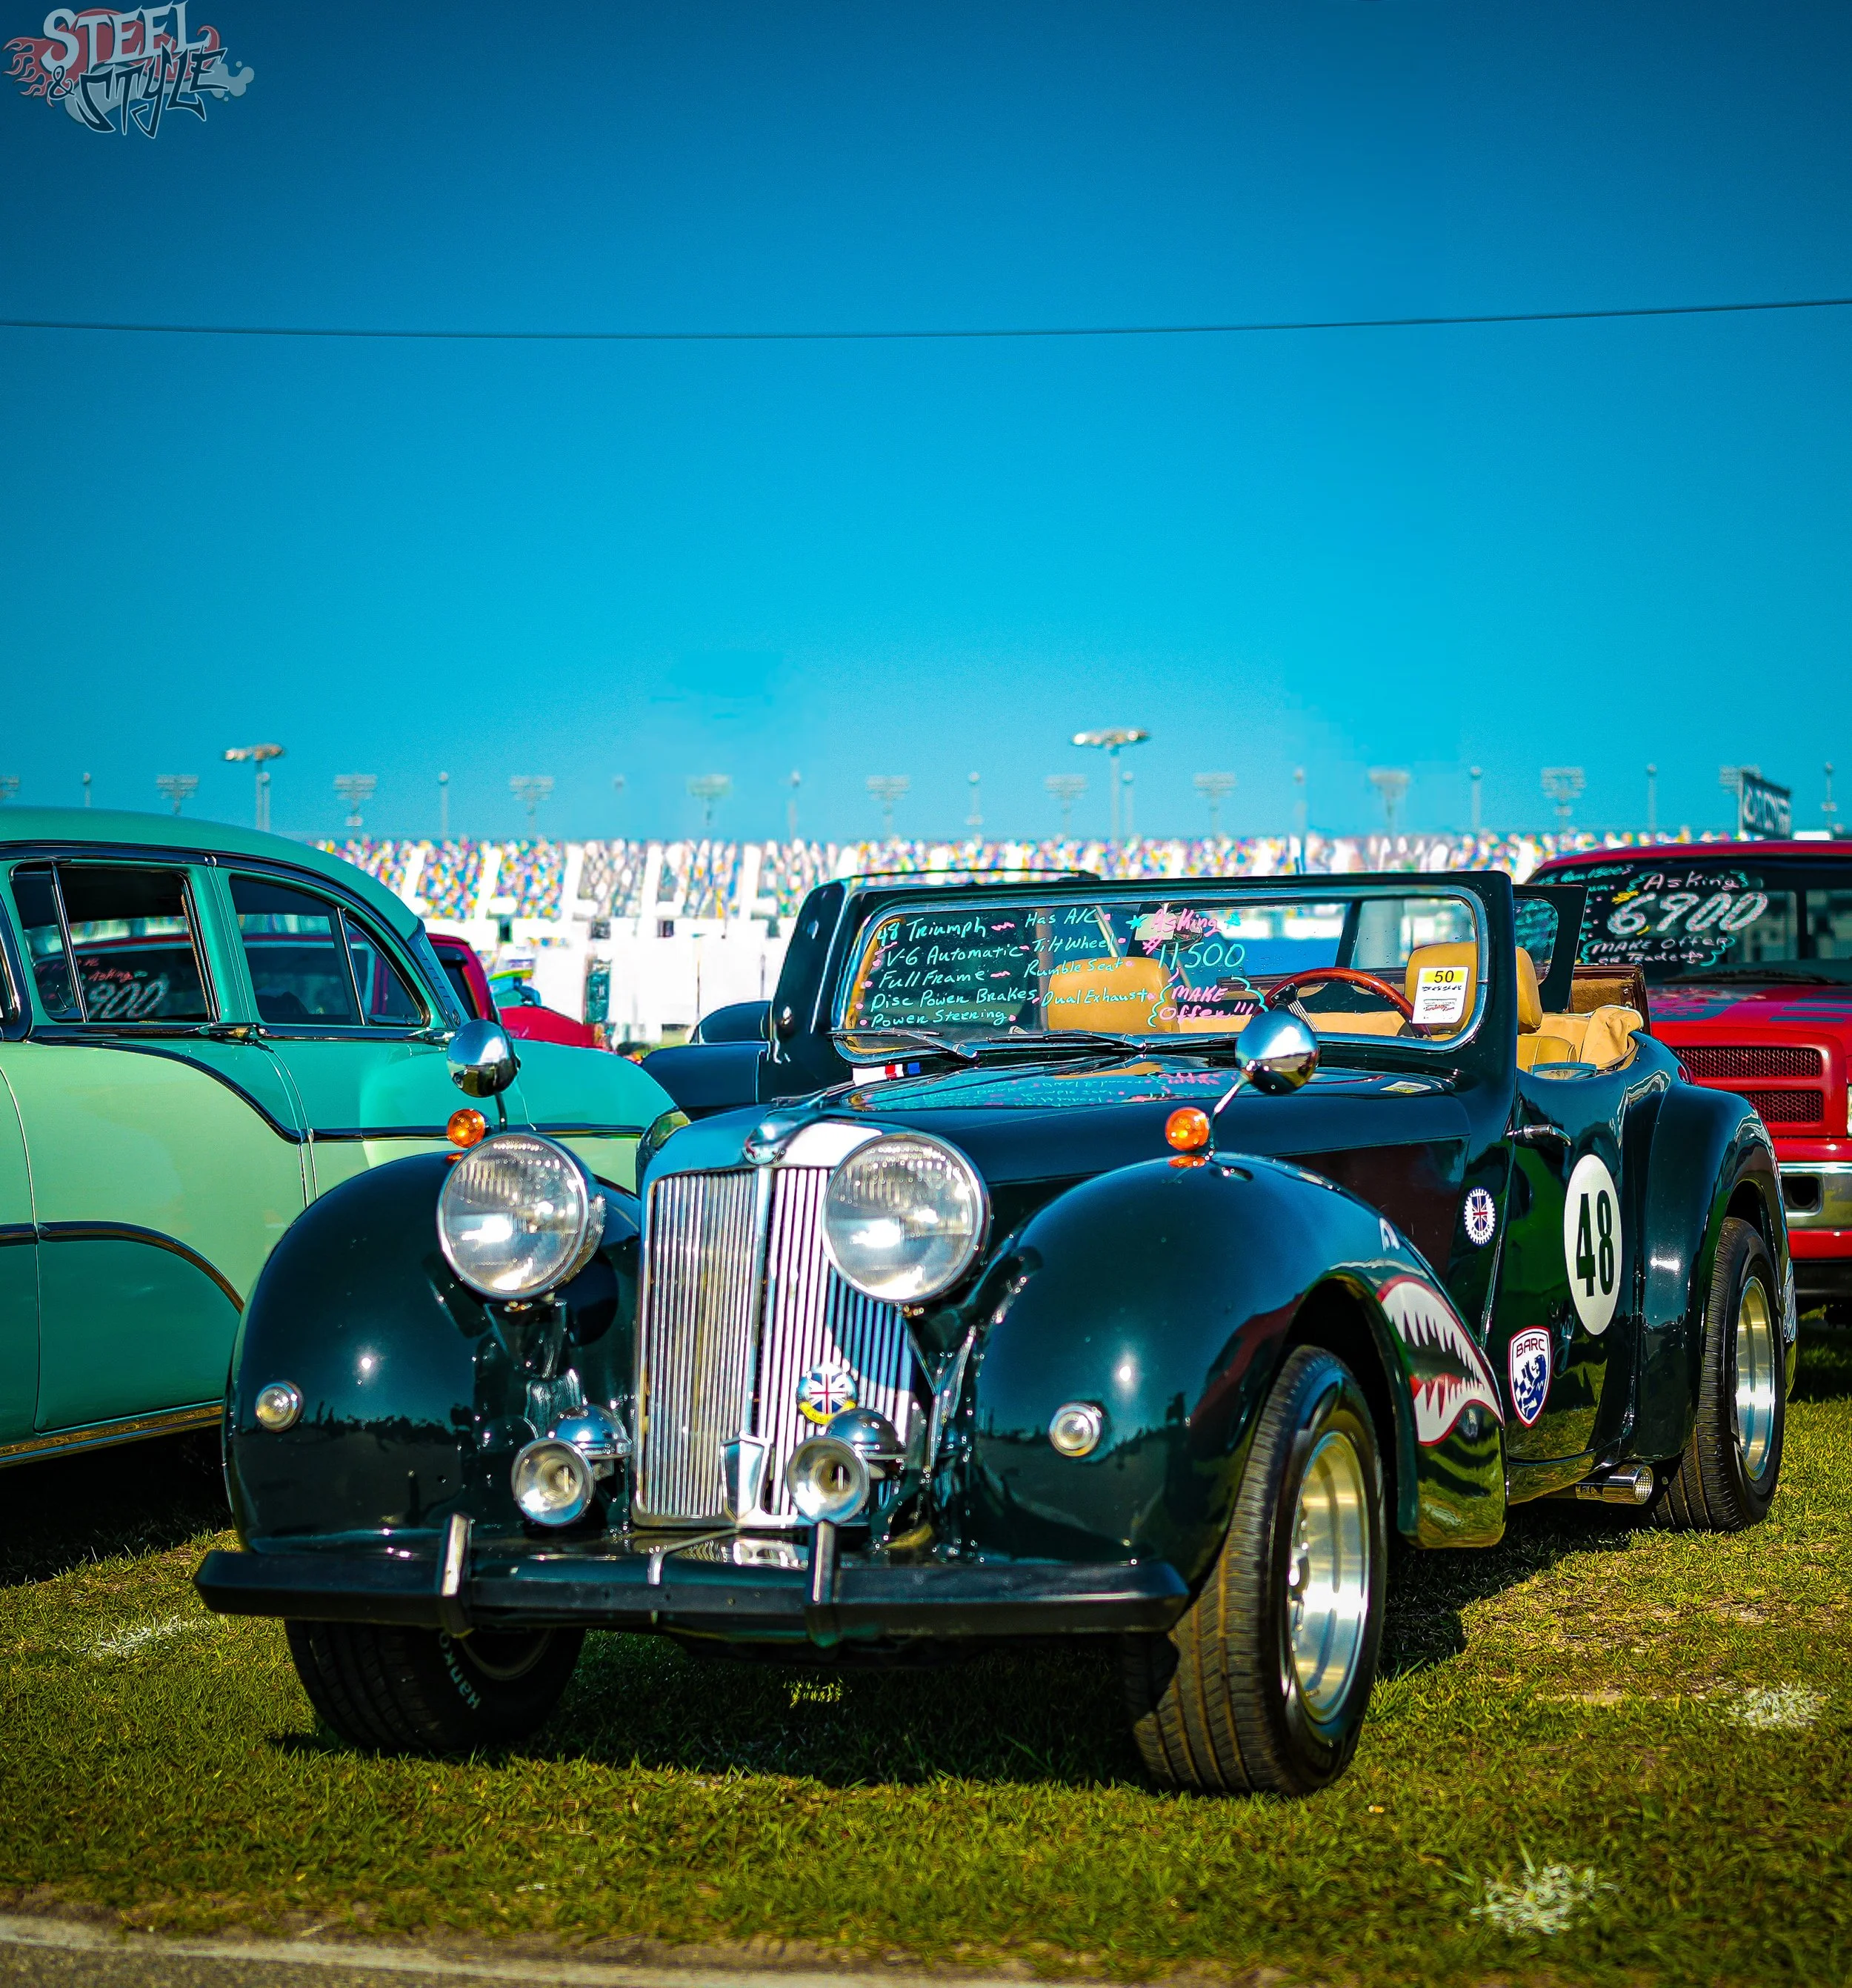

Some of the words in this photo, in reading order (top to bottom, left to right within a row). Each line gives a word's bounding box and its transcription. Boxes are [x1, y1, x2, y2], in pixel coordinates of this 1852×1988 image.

[1025, 911, 1056, 928] Has
[1063, 908, 1100, 925] A/C
[887, 946, 920, 967] V-6
[927, 943, 1024, 965] Automatic
[1024, 959, 1082, 978] Rumble
[1087, 957, 1124, 972] Seat
[1434, 970, 1454, 983] 50
[879, 970, 919, 989] Full
[870, 993, 914, 1013] Disc
[1041, 990, 1082, 1008] Dual
[1084, 987, 1147, 1004] Exhaust
[1576, 1189, 1615, 1297] 48
[1516, 1337, 1545, 1358] BARC
